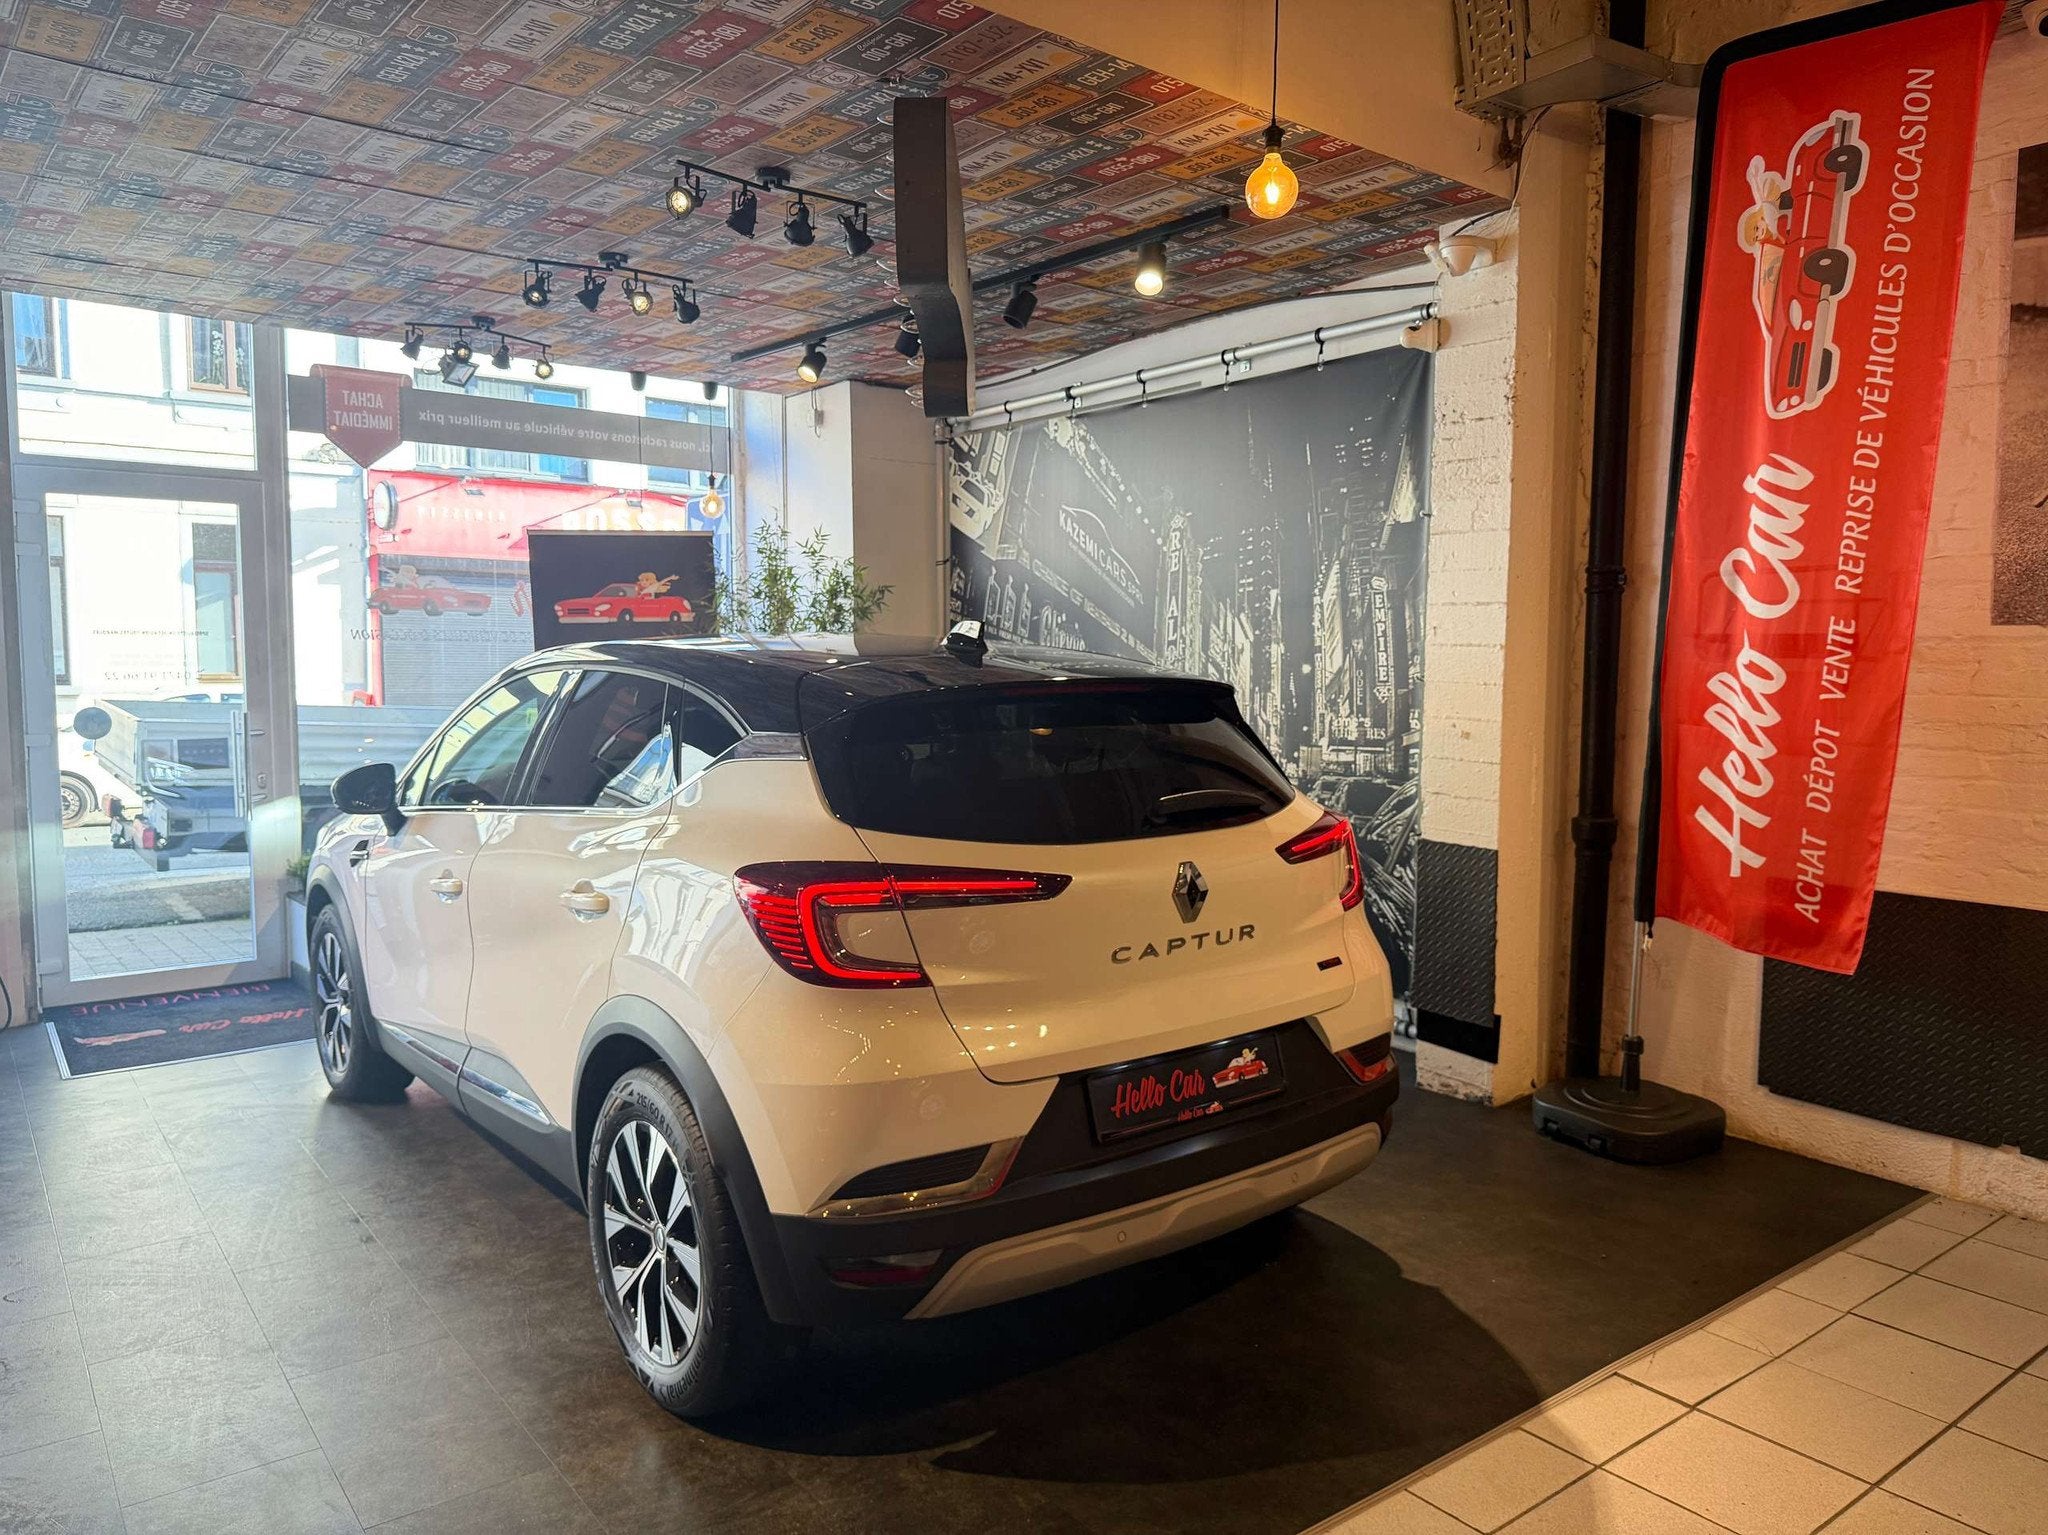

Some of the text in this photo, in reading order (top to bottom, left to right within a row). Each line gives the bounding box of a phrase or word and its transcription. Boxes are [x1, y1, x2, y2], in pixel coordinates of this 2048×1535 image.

[1794, 68, 1935, 924] ACHAT DÉPOT VENTE REPRISE DE VÉHICULES D'OCCASION
[1373, 591, 1391, 684] EMPIRE
[1695, 451, 1815, 878] Hello Car
[1110, 923, 1256, 965] CAPTUR
[1110, 1067, 1206, 1119] Hello Car
